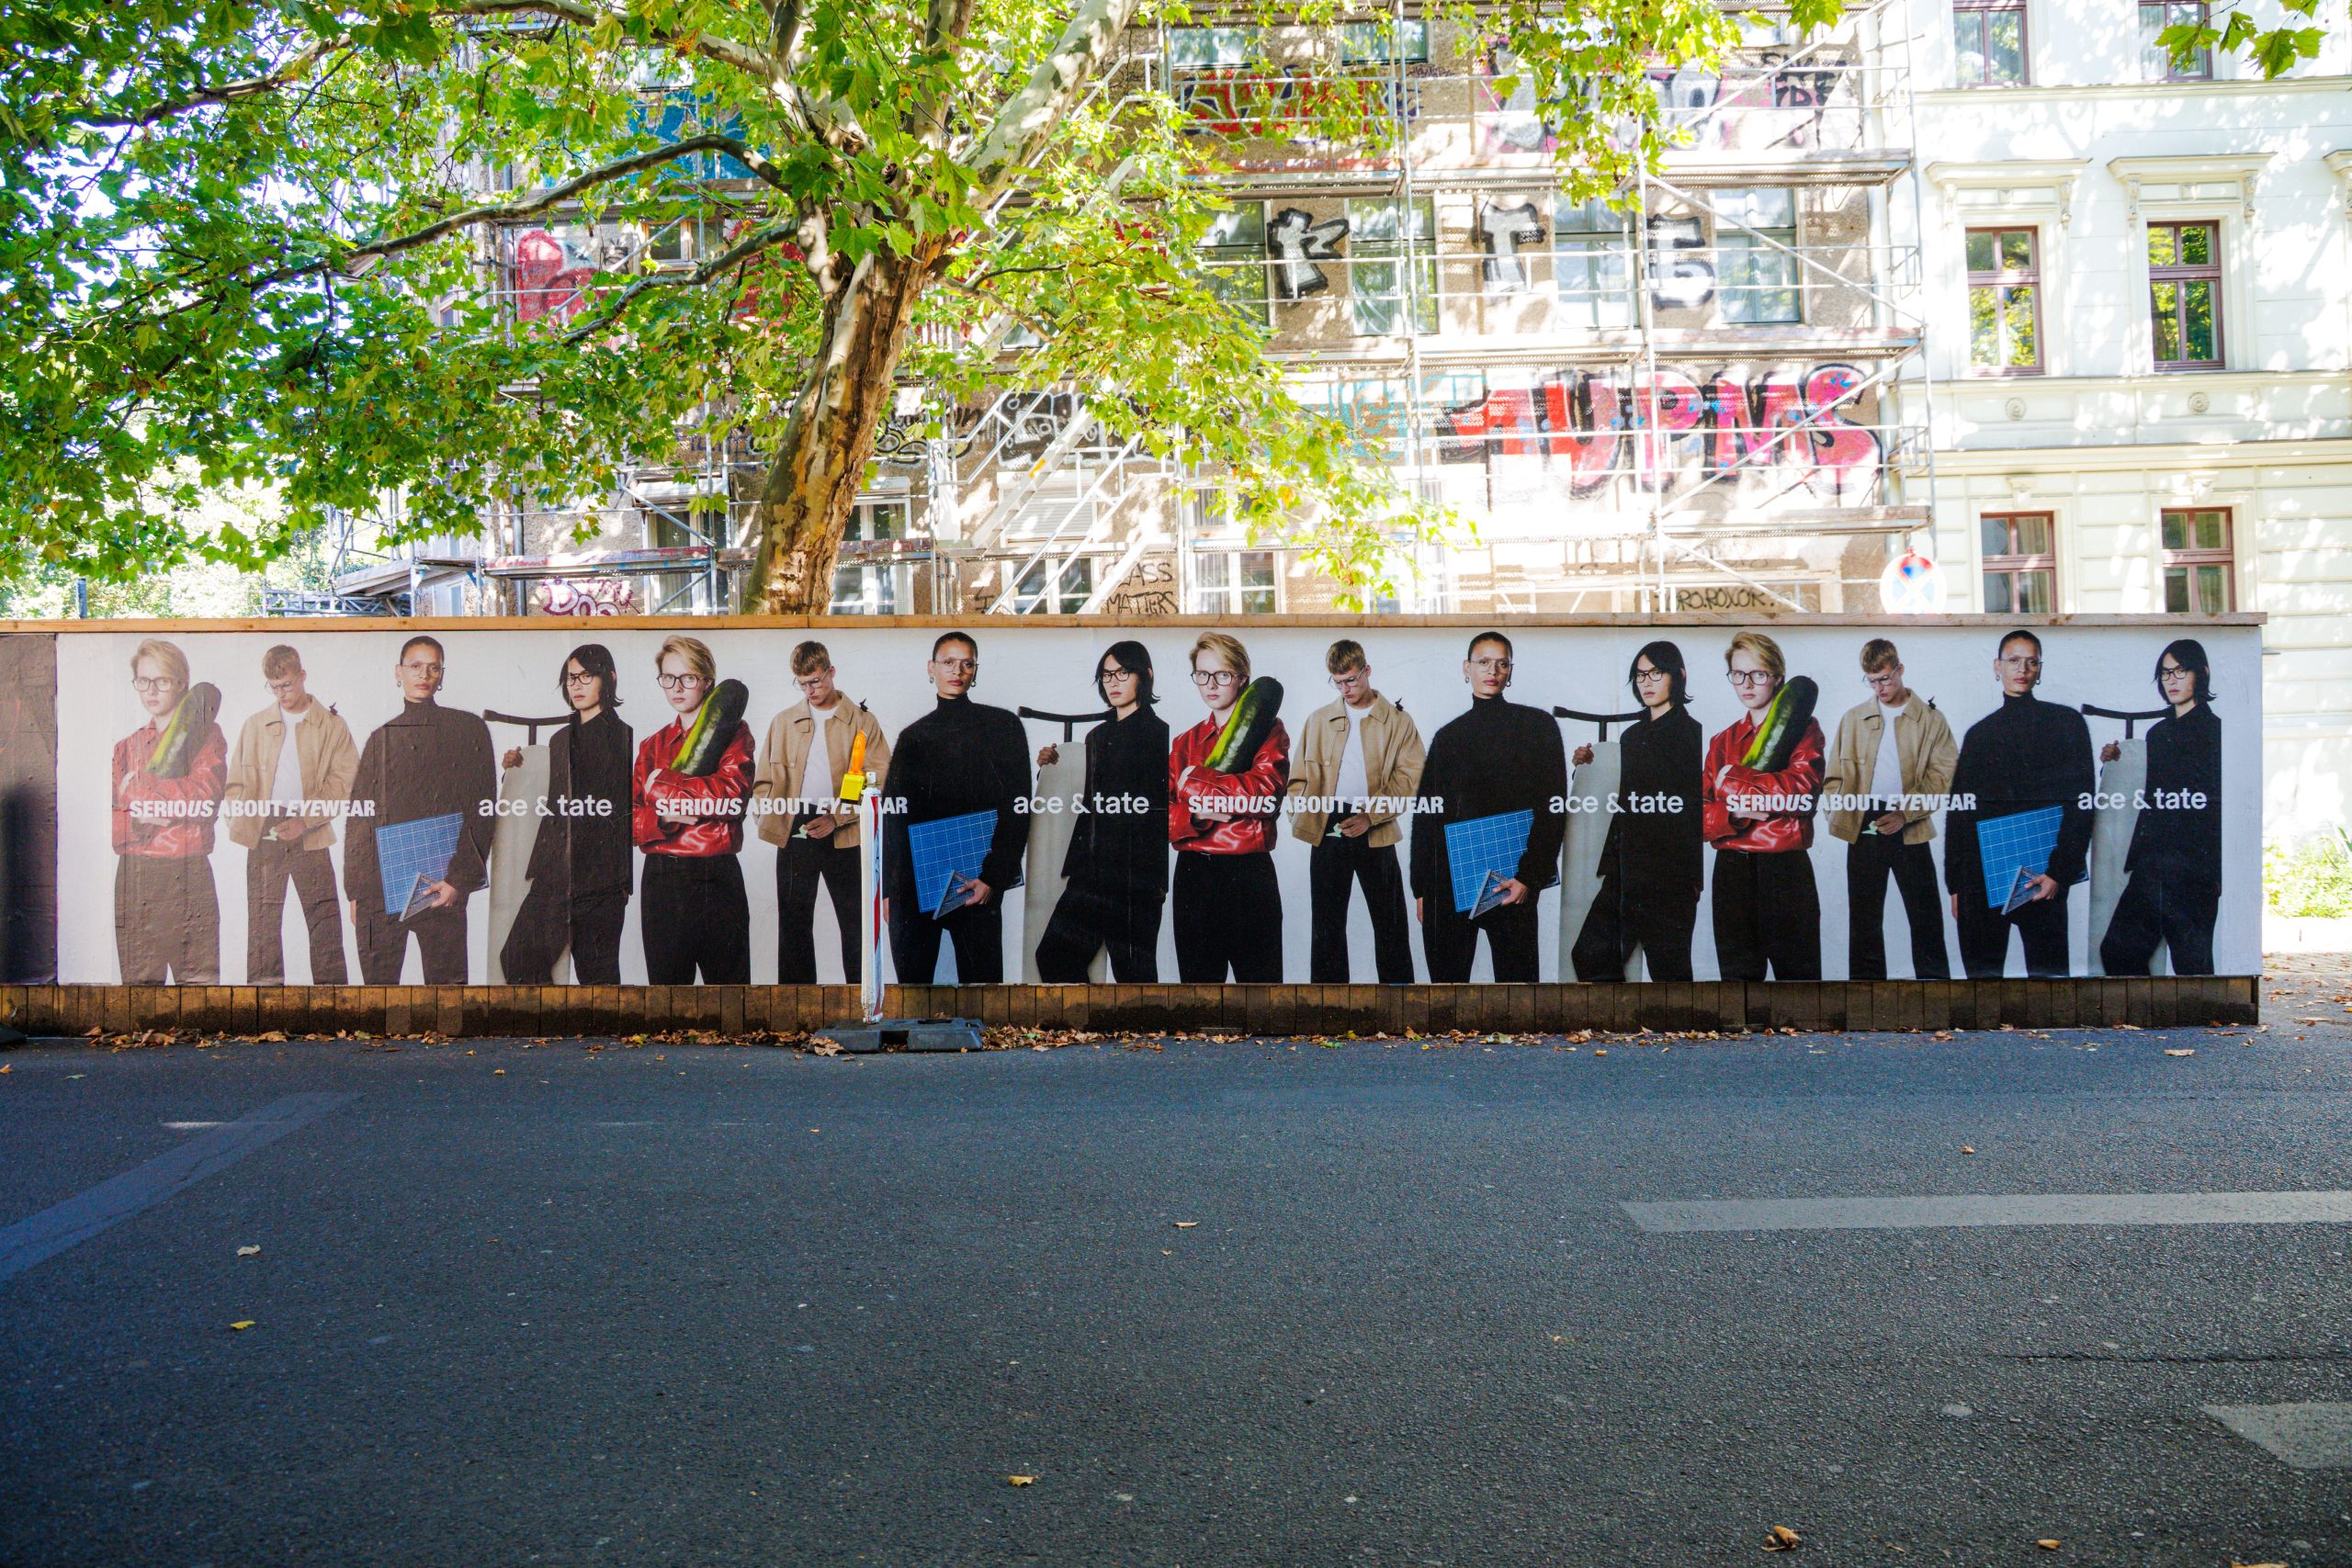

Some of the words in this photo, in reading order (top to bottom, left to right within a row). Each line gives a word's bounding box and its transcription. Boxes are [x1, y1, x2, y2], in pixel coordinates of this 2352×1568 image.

[129, 799, 215, 818] SERIOUS
[217, 799, 284, 818] ABOUT
[287, 799, 375, 817] EYEWEAR
[479, 798, 528, 817] ace
[535, 795, 555, 817] &
[557, 794, 613, 817] tate
[655, 797, 742, 816] SERIOUS
[745, 797, 812, 815] ABOUT
[816, 796, 908, 814] EYEAR
[1013, 795, 1064, 814] ace
[1070, 793, 1091, 814] &
[1093, 792, 1149, 814] tate
[1188, 795, 1276, 814] SERIOUS
[1280, 795, 1348, 813] ABOUT
[1351, 795, 1444, 813] EYEWEAR
[1549, 795, 1599, 814] ace
[1606, 792, 1626, 814] &
[1628, 791, 1684, 814] tate
[1725, 794, 1813, 812] SERIOUS
[1815, 794, 1882, 811] ABOUT
[1884, 793, 1976, 810] EYEWEAR
[2077, 792, 2126, 810] ace
[2132, 789, 2152, 810] &
[2154, 787, 2208, 809] tate
